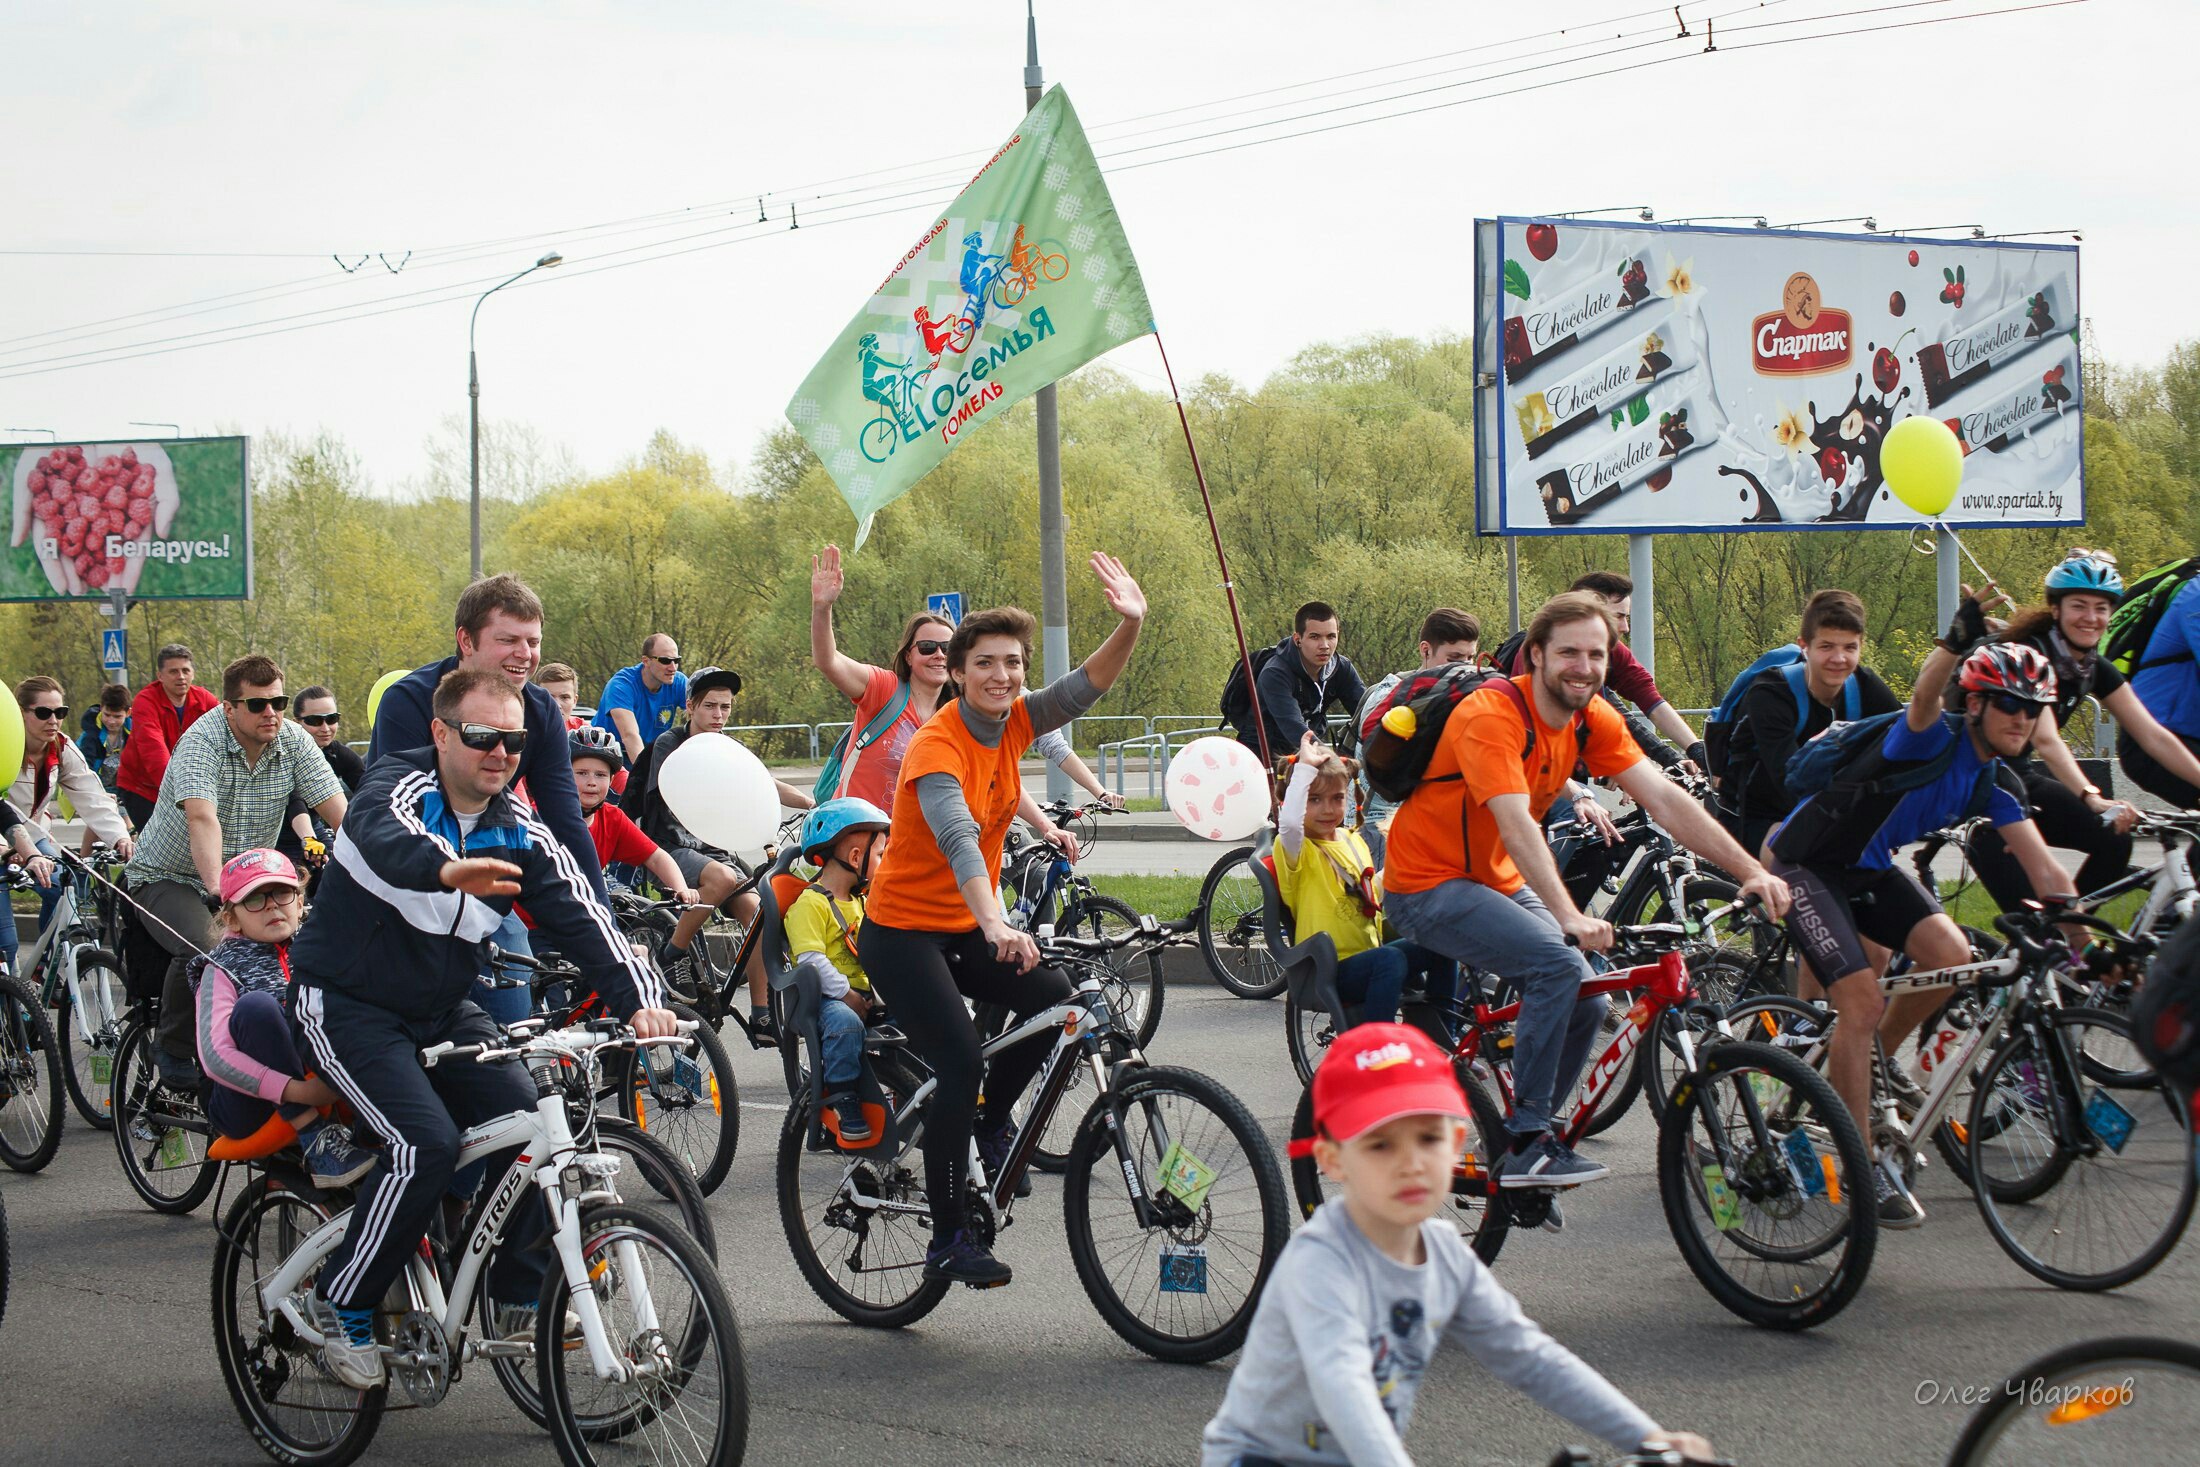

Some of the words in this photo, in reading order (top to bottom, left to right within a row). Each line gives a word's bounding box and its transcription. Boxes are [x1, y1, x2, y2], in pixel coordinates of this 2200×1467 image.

[1526, 291, 1611, 347] Chocolate
[1756, 318, 1848, 360] Спартак
[1945, 321, 2021, 371] Chocolate
[941, 381, 1004, 445] ГОМЕЛЬ
[1546, 364, 1631, 420] Chocolate
[1963, 396, 2038, 444] Chocolate
[1569, 440, 1653, 496] Chocolate
[1962, 490, 2063, 517] www.spartak.by
[41, 537, 59, 560] Я
[105, 534, 230, 564] Беларусь!
[241, 855, 263, 869] SPORT
[1790, 886, 1839, 954] SUISSE
